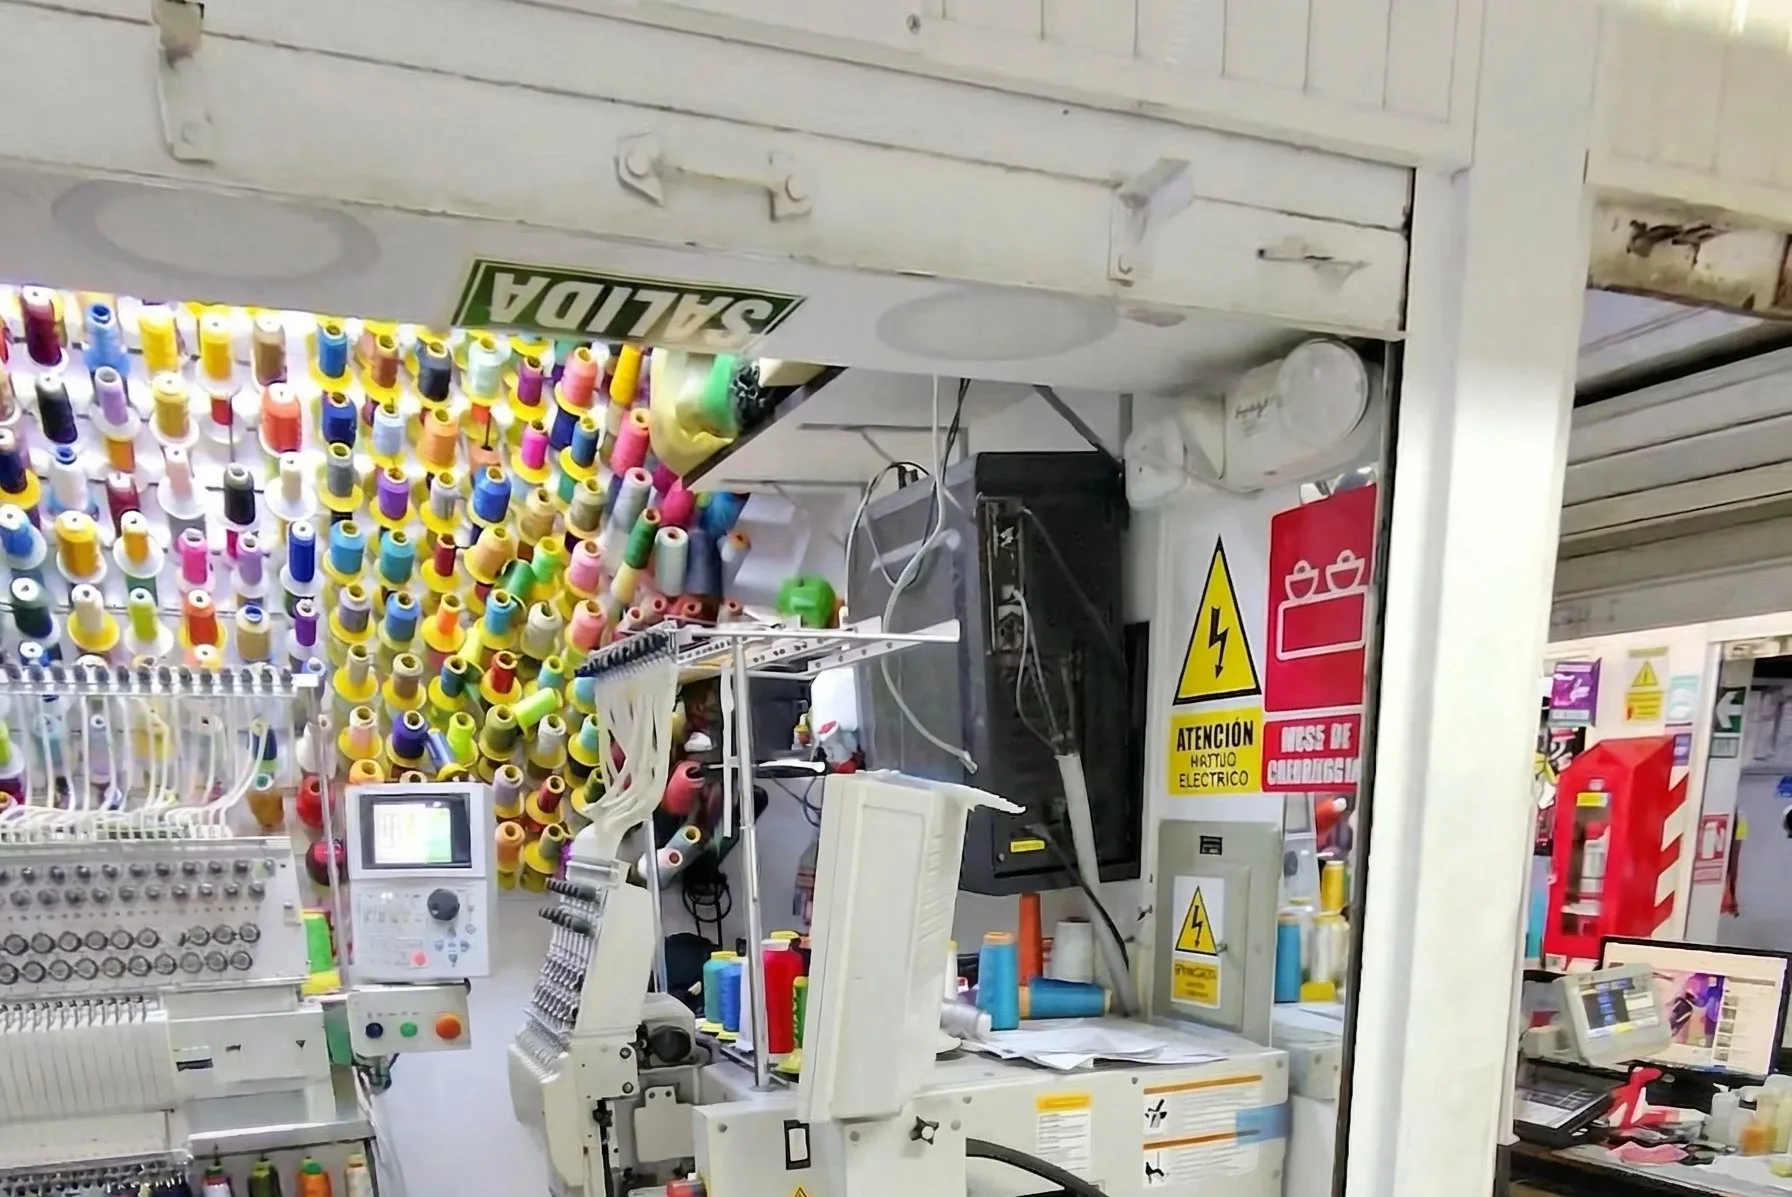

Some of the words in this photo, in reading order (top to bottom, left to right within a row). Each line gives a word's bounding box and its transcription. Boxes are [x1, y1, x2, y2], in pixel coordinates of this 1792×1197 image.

[490, 271, 774, 348] SALIDA
[1176, 716, 1254, 752] ATENCIÓN
[1179, 770, 1249, 788] ELECTRICO
